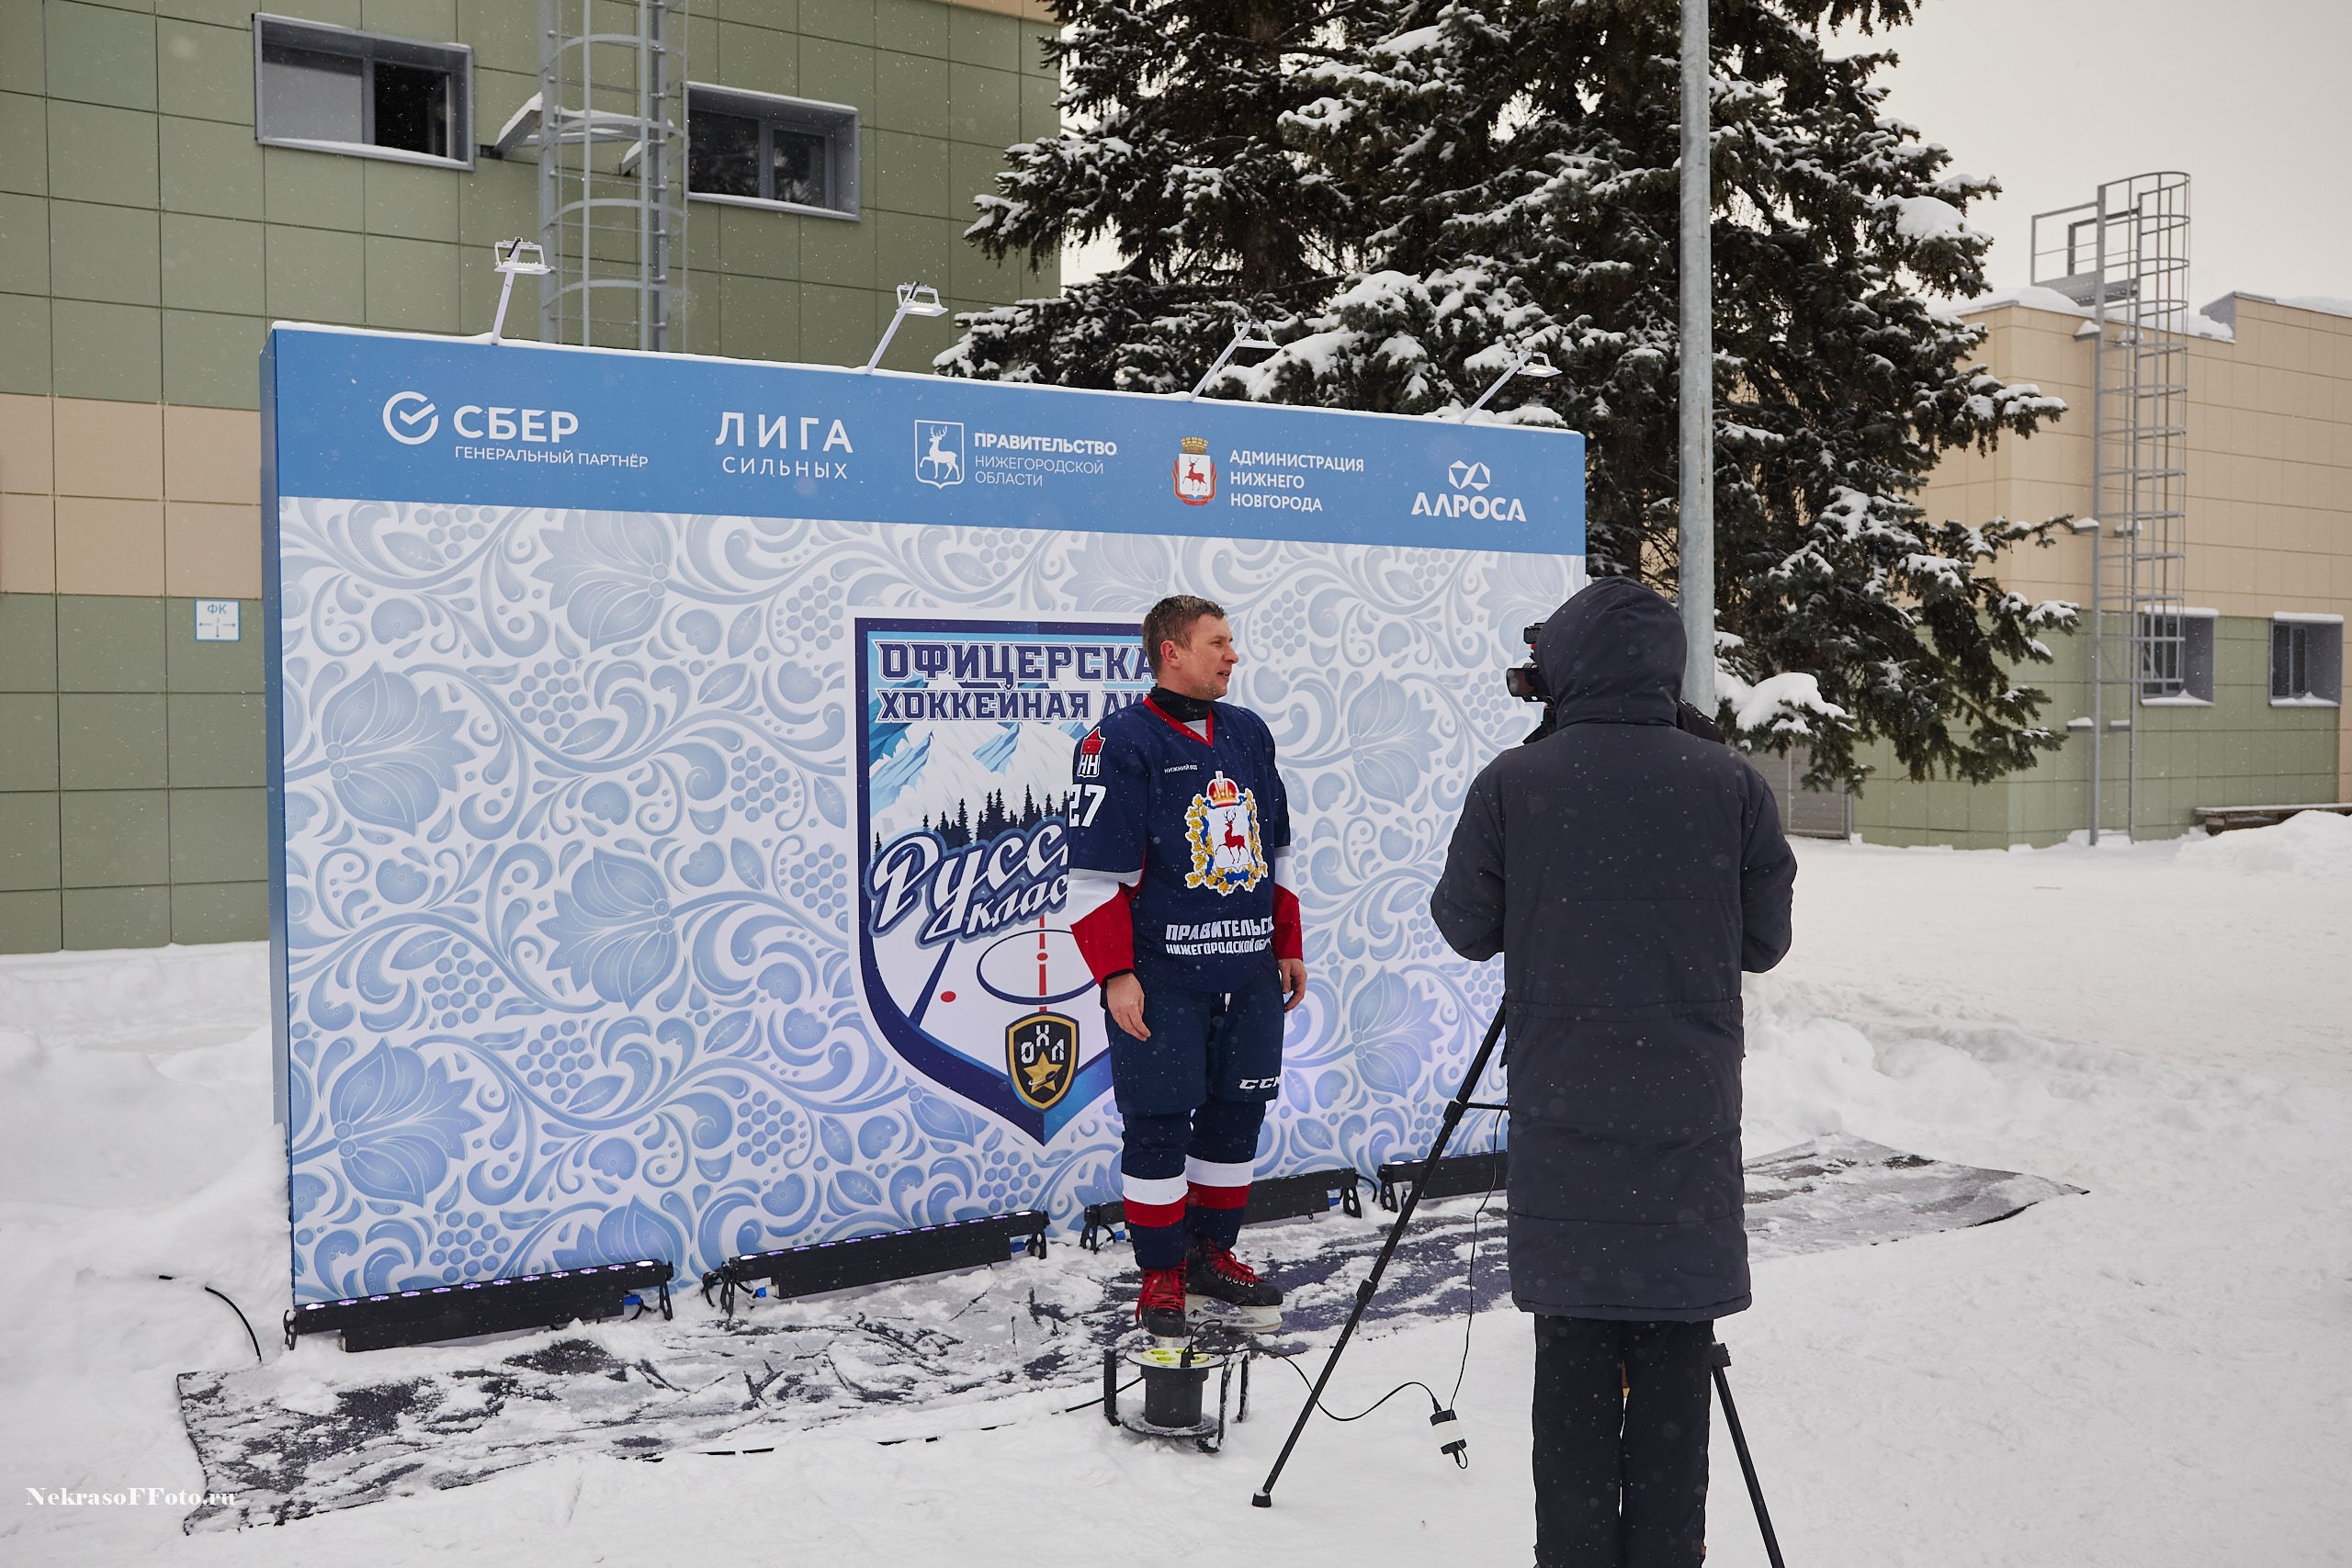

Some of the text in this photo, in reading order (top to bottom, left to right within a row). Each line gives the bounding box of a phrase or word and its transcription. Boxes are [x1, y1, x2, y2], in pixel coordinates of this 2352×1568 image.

[453, 405, 579, 444] СБЕР
[715, 412, 854, 454] ЛИГА
[455, 446, 649, 468] ГЕНЕРАЛЬНЫЙ ПАРТНЁР
[974, 433, 1117, 457] ПРАВИТЕЛЬСТВО
[721, 457, 848, 479] СИЛЬНЫХ
[975, 455, 1103, 474] НИЖЕГОРОДСКОЙ
[1229, 449, 1364, 472] АДМИНИСТРАЦИЯ
[975, 471, 1043, 487] ОБЛАСТИ
[1230, 471, 1305, 490] НИЖНЕГО
[1230, 492, 1323, 513] НОВГОРОДА
[1411, 491, 1527, 522] АЛРОСА
[876, 641, 1157, 691] ОФИЦЕРСКА
[877, 689, 1091, 720] ХОККЕЙНАЯ
[1069, 784, 1106, 827] 27
[874, 824, 1069, 940] Русс
[967, 874, 1068, 934] клас
[1165, 938, 1254, 955] НИЖЕГОРОДСКОЙ
